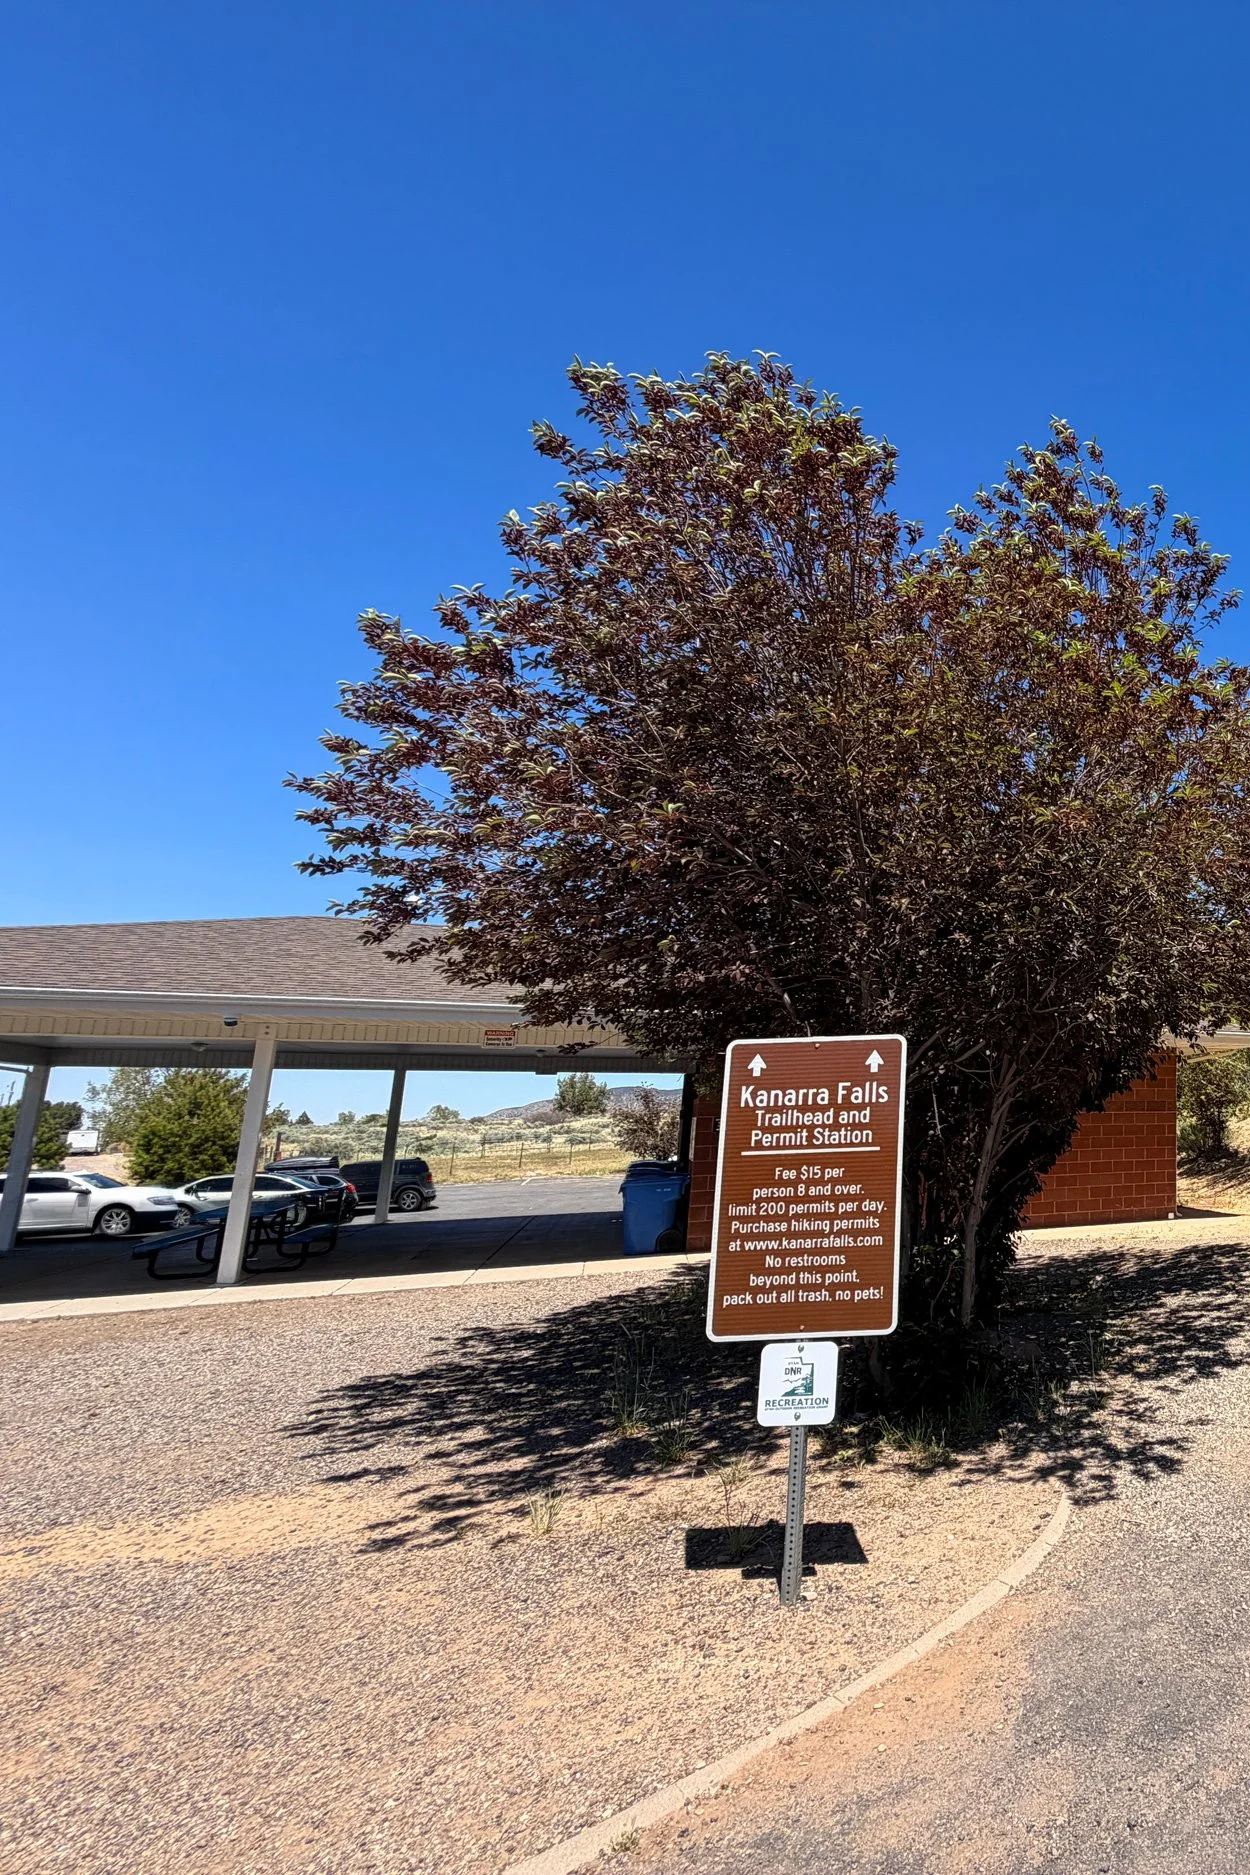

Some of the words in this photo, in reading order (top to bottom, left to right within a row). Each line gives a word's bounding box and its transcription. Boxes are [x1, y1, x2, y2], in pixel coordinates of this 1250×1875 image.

[740, 1086, 828, 1107] Kanarra
[838, 1081, 888, 1104] Falls
[756, 1108, 834, 1127] Trailhead
[839, 1107, 870, 1124] and
[751, 1129, 808, 1146] Permit
[813, 1127, 872, 1145] Station
[775, 1168, 796, 1180] Fee
[800, 1165, 821, 1180] $15
[824, 1167, 845, 1180] per
[753, 1186, 793, 1200] person
[798, 1184, 805, 1196] 8
[808, 1183, 831, 1196] and
[834, 1184, 864, 1195] over.
[728, 1204, 756, 1216] limit
[760, 1202, 785, 1215] 200
[789, 1200, 835, 1216] permits
[839, 1202, 858, 1215] per
[862, 1199, 887, 1213] day.
[731, 1221, 787, 1234] Purchase
[791, 1218, 829, 1233] hiking
[834, 1217, 879, 1231] permits
[729, 1239, 740, 1251] at
[744, 1235, 883, 1250] www.kanarrafalls.com
[766, 1255, 781, 1268] No
[785, 1254, 846, 1267] restrooms
[750, 1272, 796, 1288] beyond
[800, 1271, 821, 1284] this
[723, 1292, 753, 1308] pack
[756, 1291, 777, 1304] out
[780, 1290, 794, 1302] all
[836, 1290, 850, 1300] no
[854, 1286, 883, 1302] pets!
[784, 1367, 802, 1375] DNR
[764, 1397, 829, 1407] RECREATION
